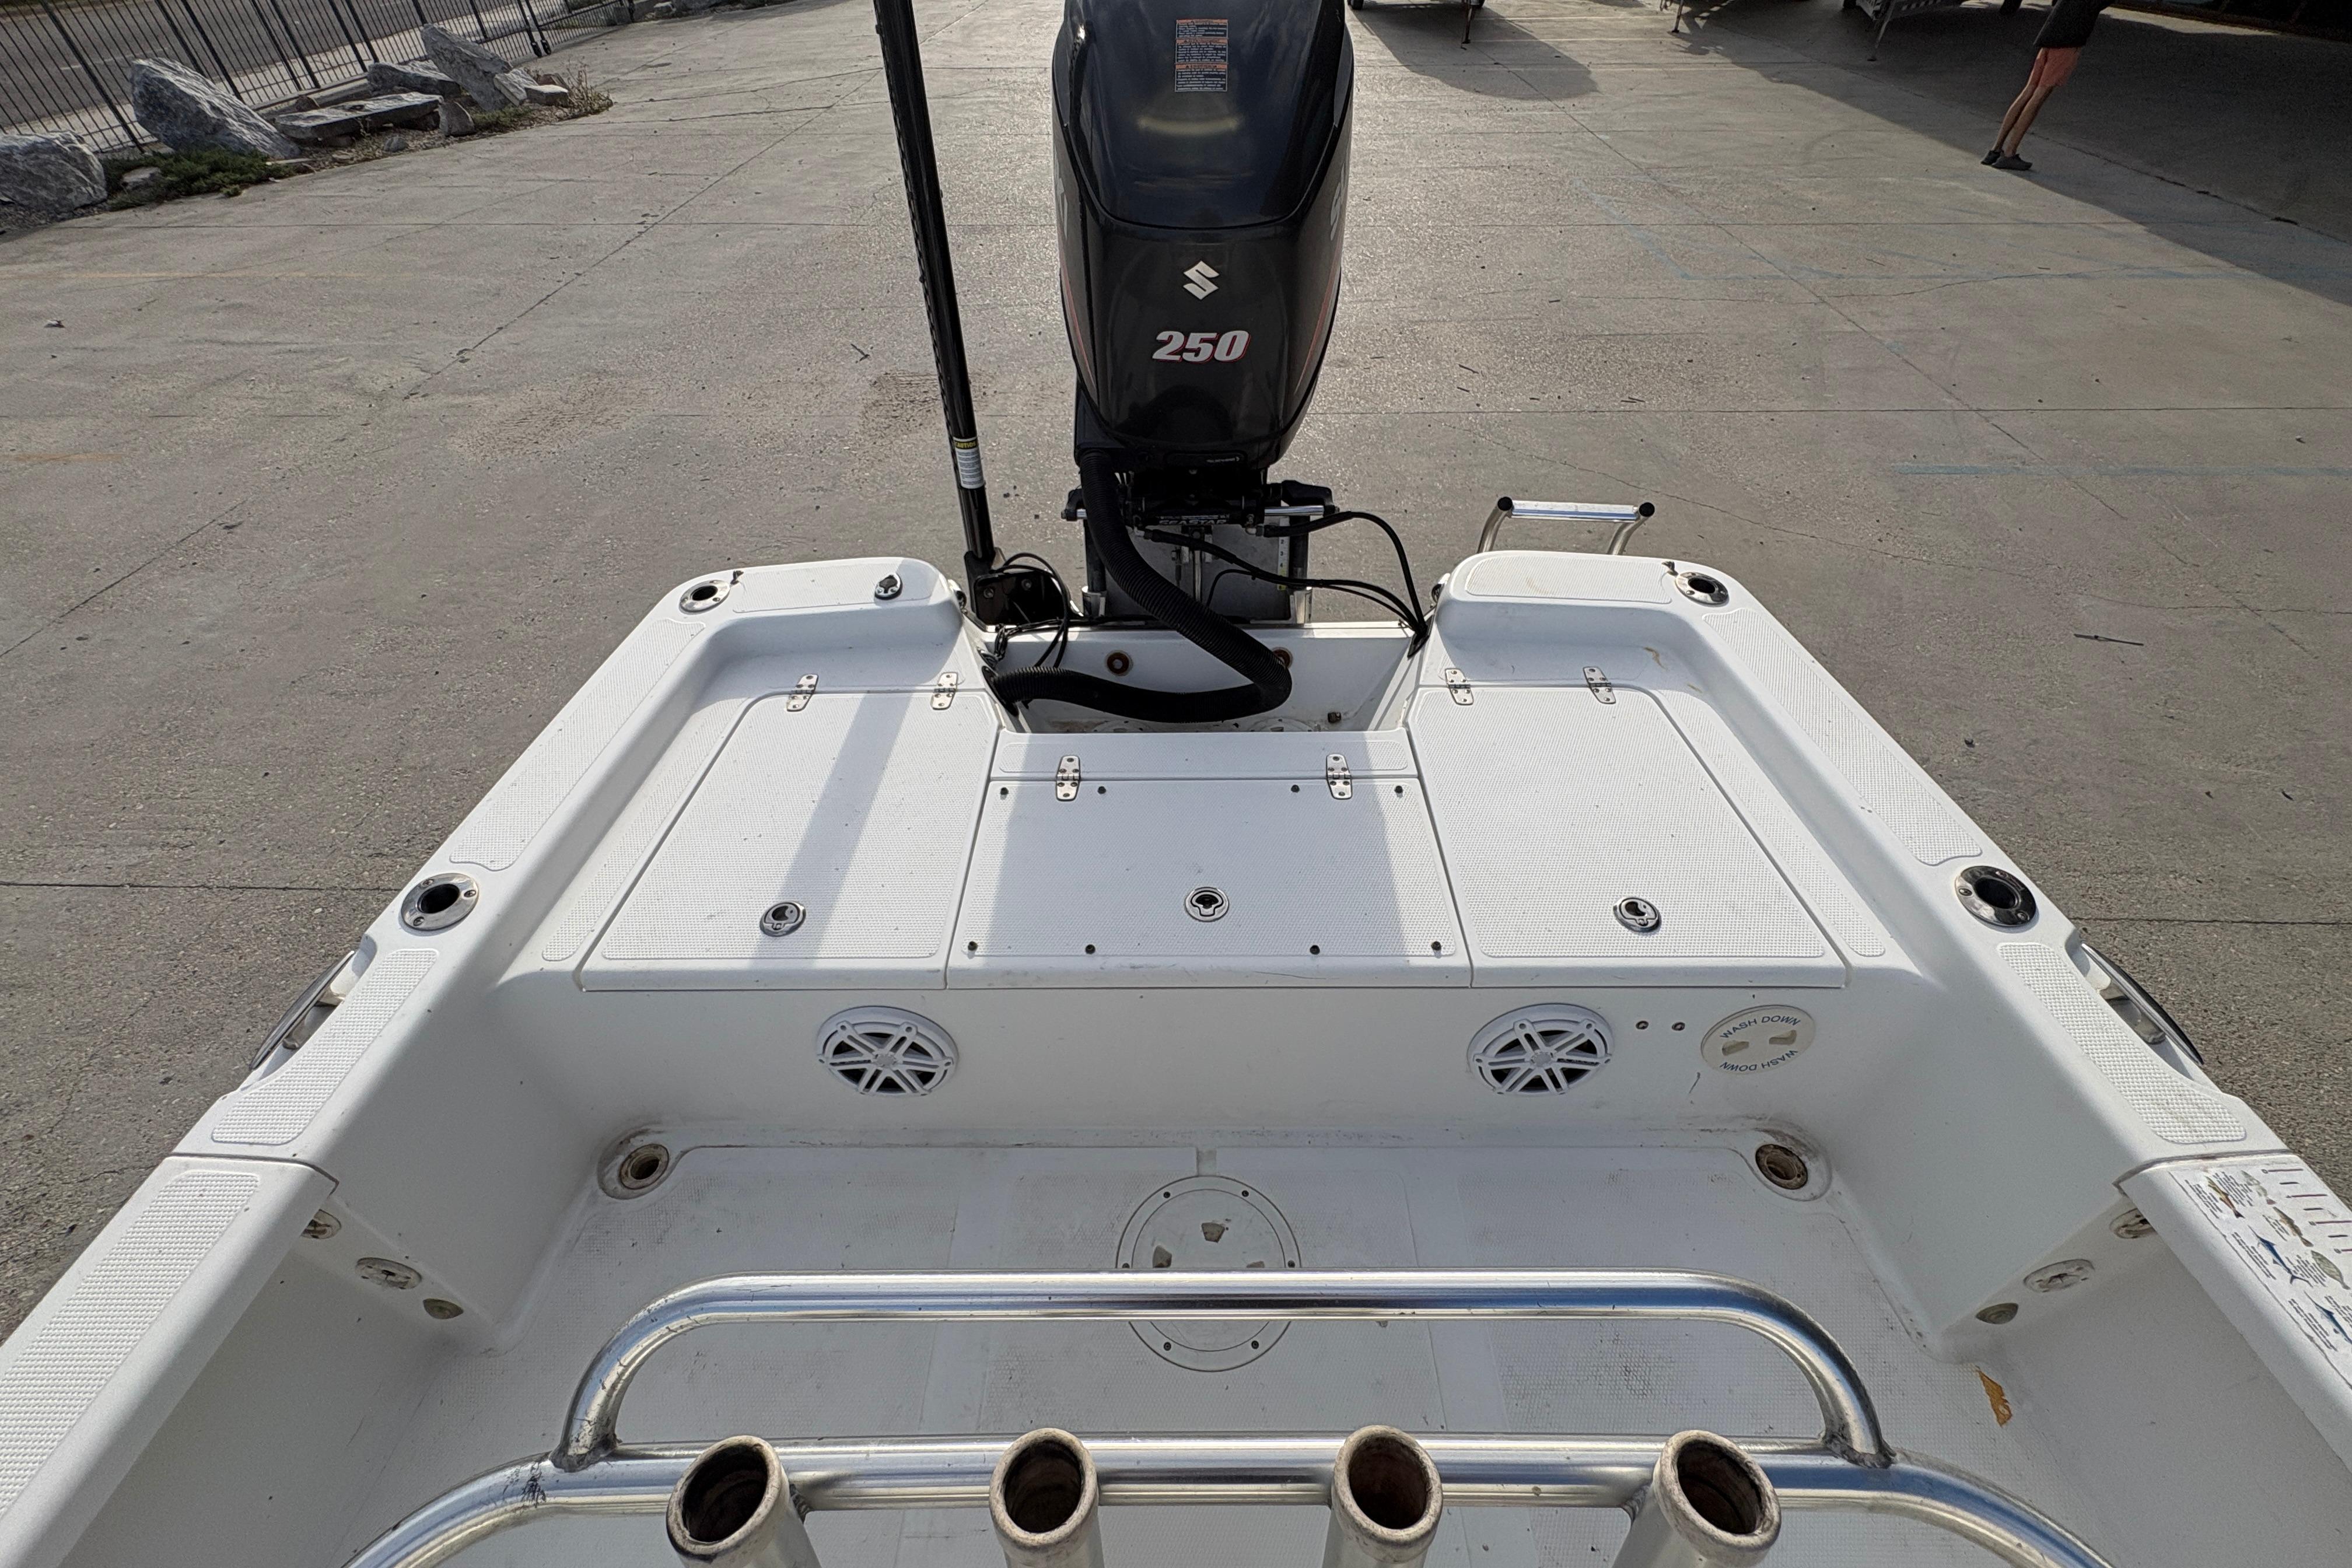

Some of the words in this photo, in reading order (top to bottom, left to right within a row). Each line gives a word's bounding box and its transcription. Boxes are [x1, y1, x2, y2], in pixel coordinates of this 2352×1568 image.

[1152, 330, 1251, 363] 250
[1720, 1019, 1758, 1039] WASH
[1761, 1015, 1801, 1026] DOWN
[1719, 1061, 1758, 1072] DOWN
[1761, 1050, 1798, 1069] WASH
